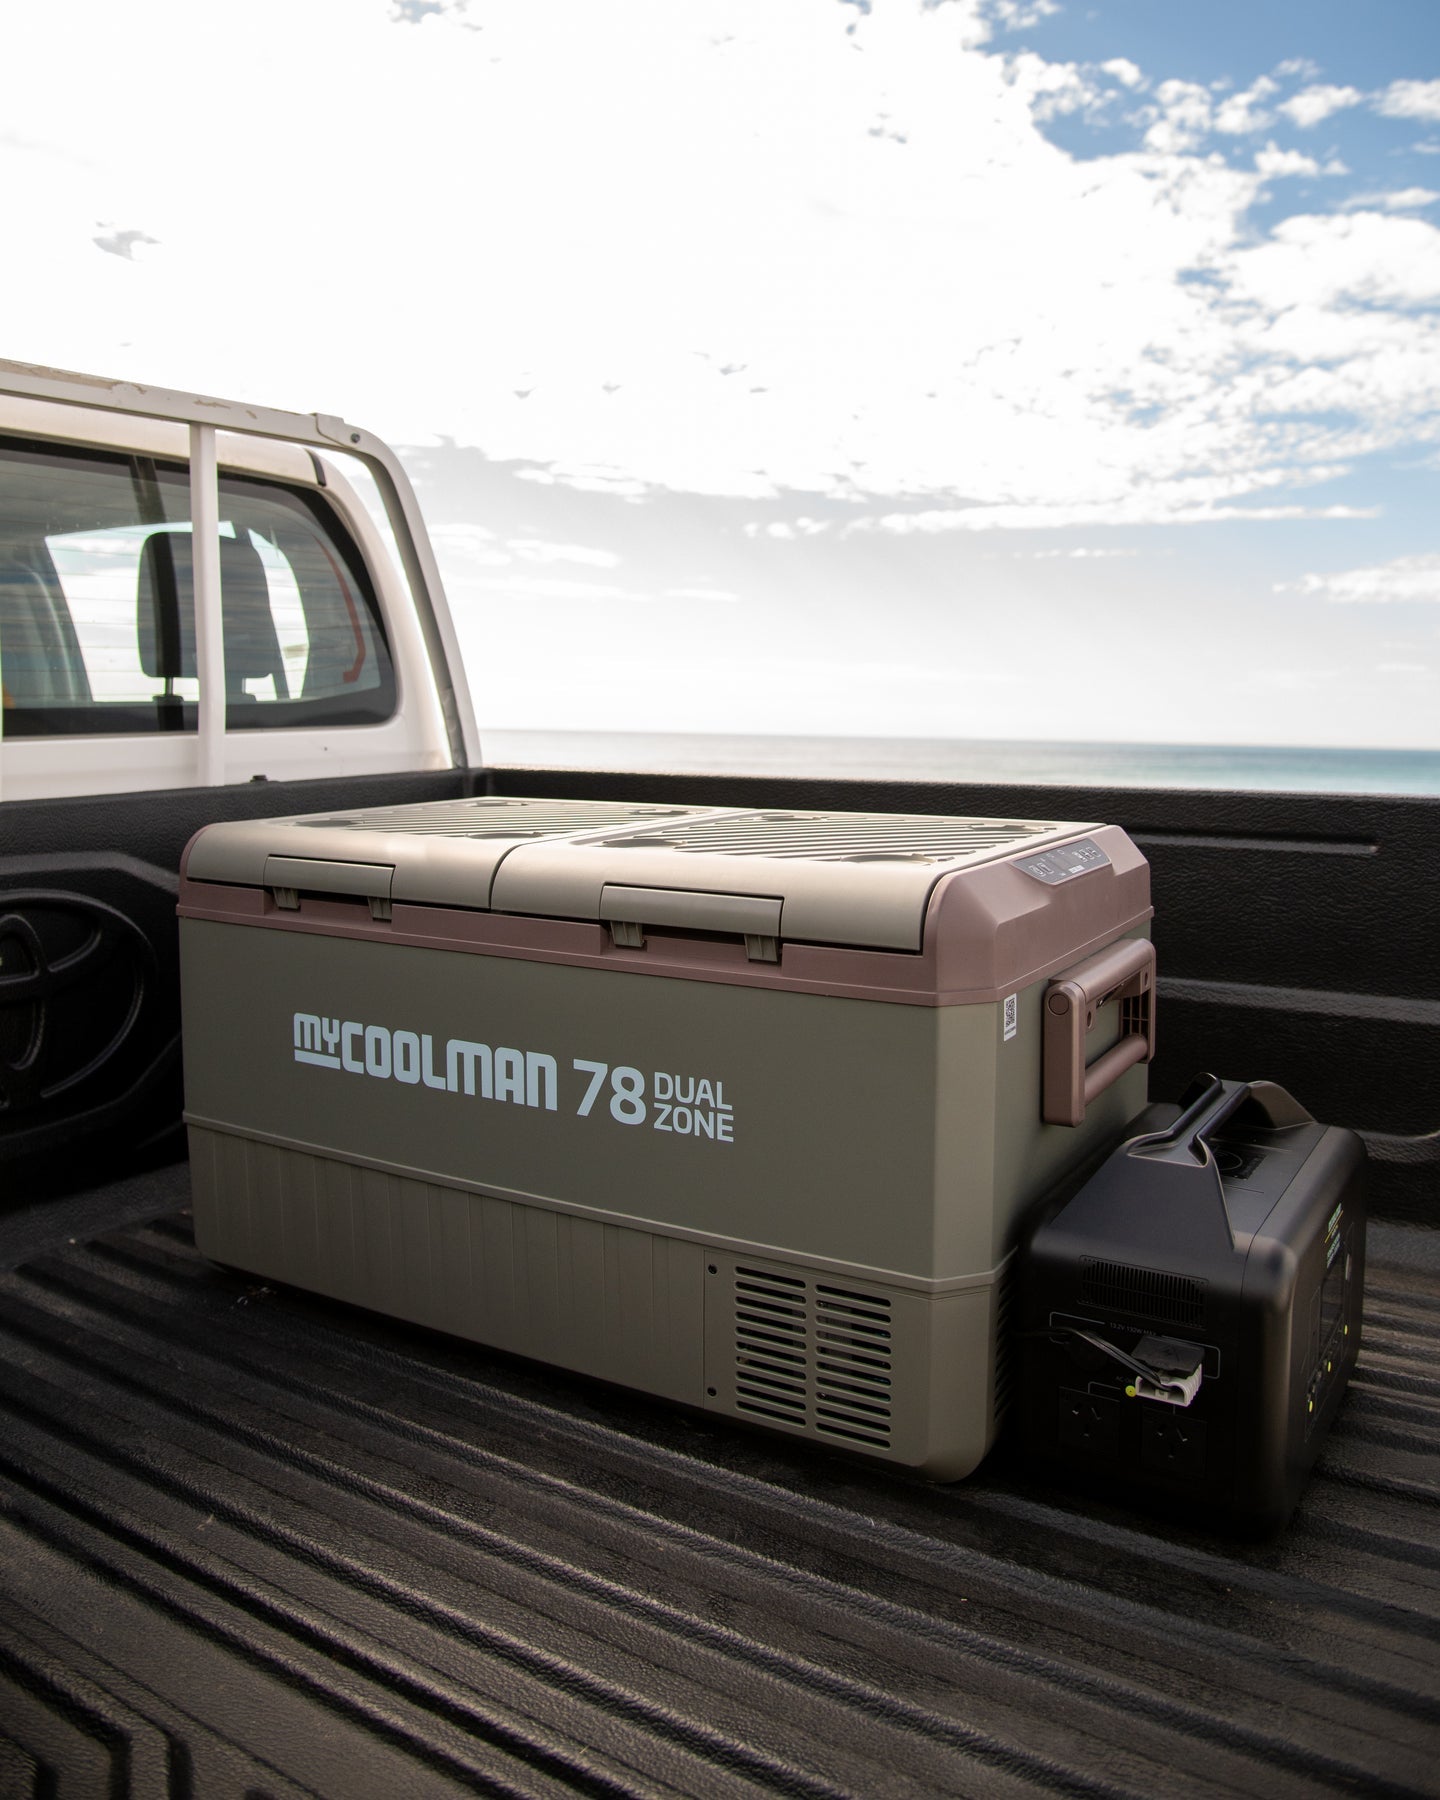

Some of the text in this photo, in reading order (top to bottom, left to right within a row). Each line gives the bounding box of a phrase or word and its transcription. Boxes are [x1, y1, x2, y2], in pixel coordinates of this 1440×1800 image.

[574, 1059, 646, 1124] 78
[655, 1072, 732, 1110] DUAL
[654, 1103, 733, 1142] ZONE
